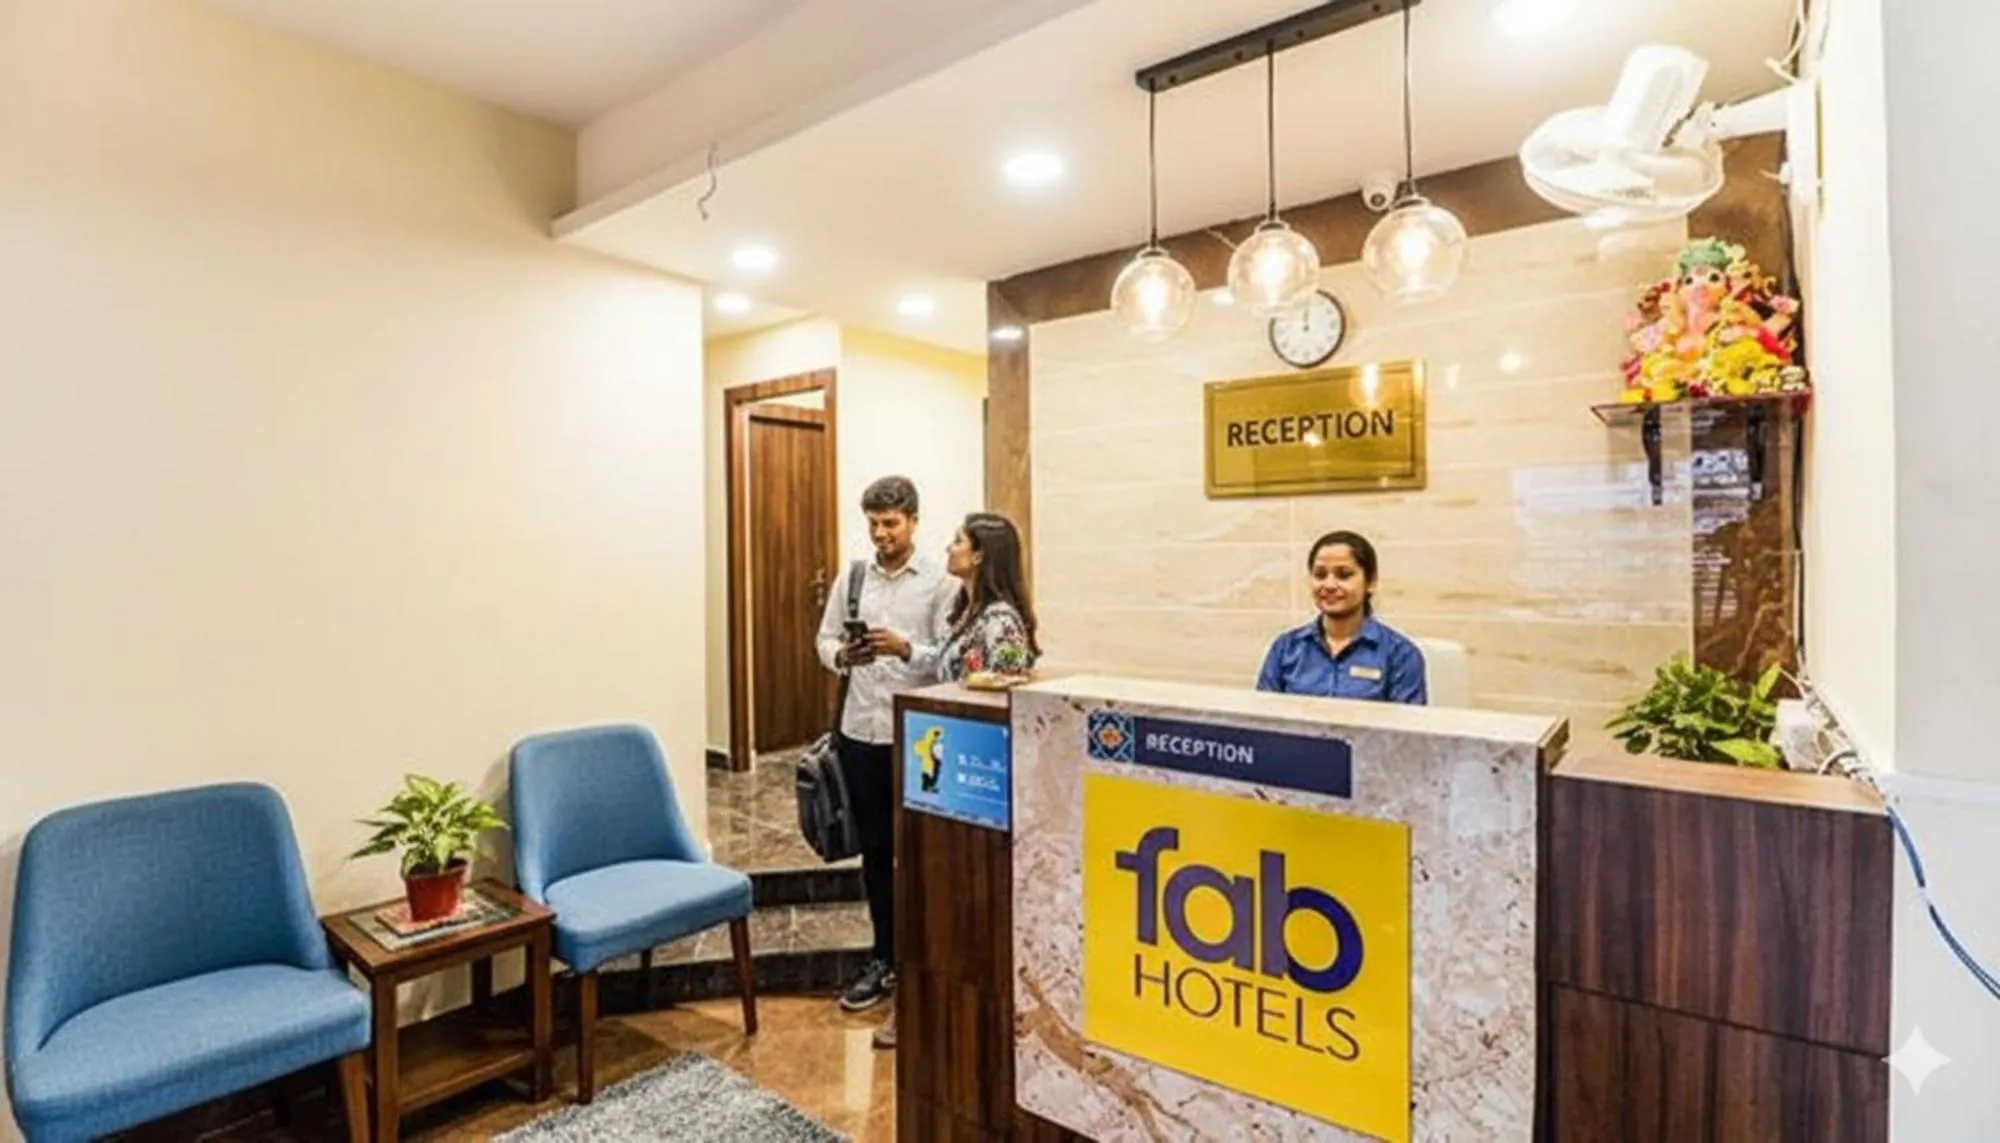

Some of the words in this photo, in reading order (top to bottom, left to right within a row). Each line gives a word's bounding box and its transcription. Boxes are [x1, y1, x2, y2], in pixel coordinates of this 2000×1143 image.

[1226, 410, 1395, 448] RECEPTION
[1145, 732, 1254, 765] RECEPTION
[1114, 825, 1365, 993] fab
[1133, 953, 1361, 1062] HOTELS
